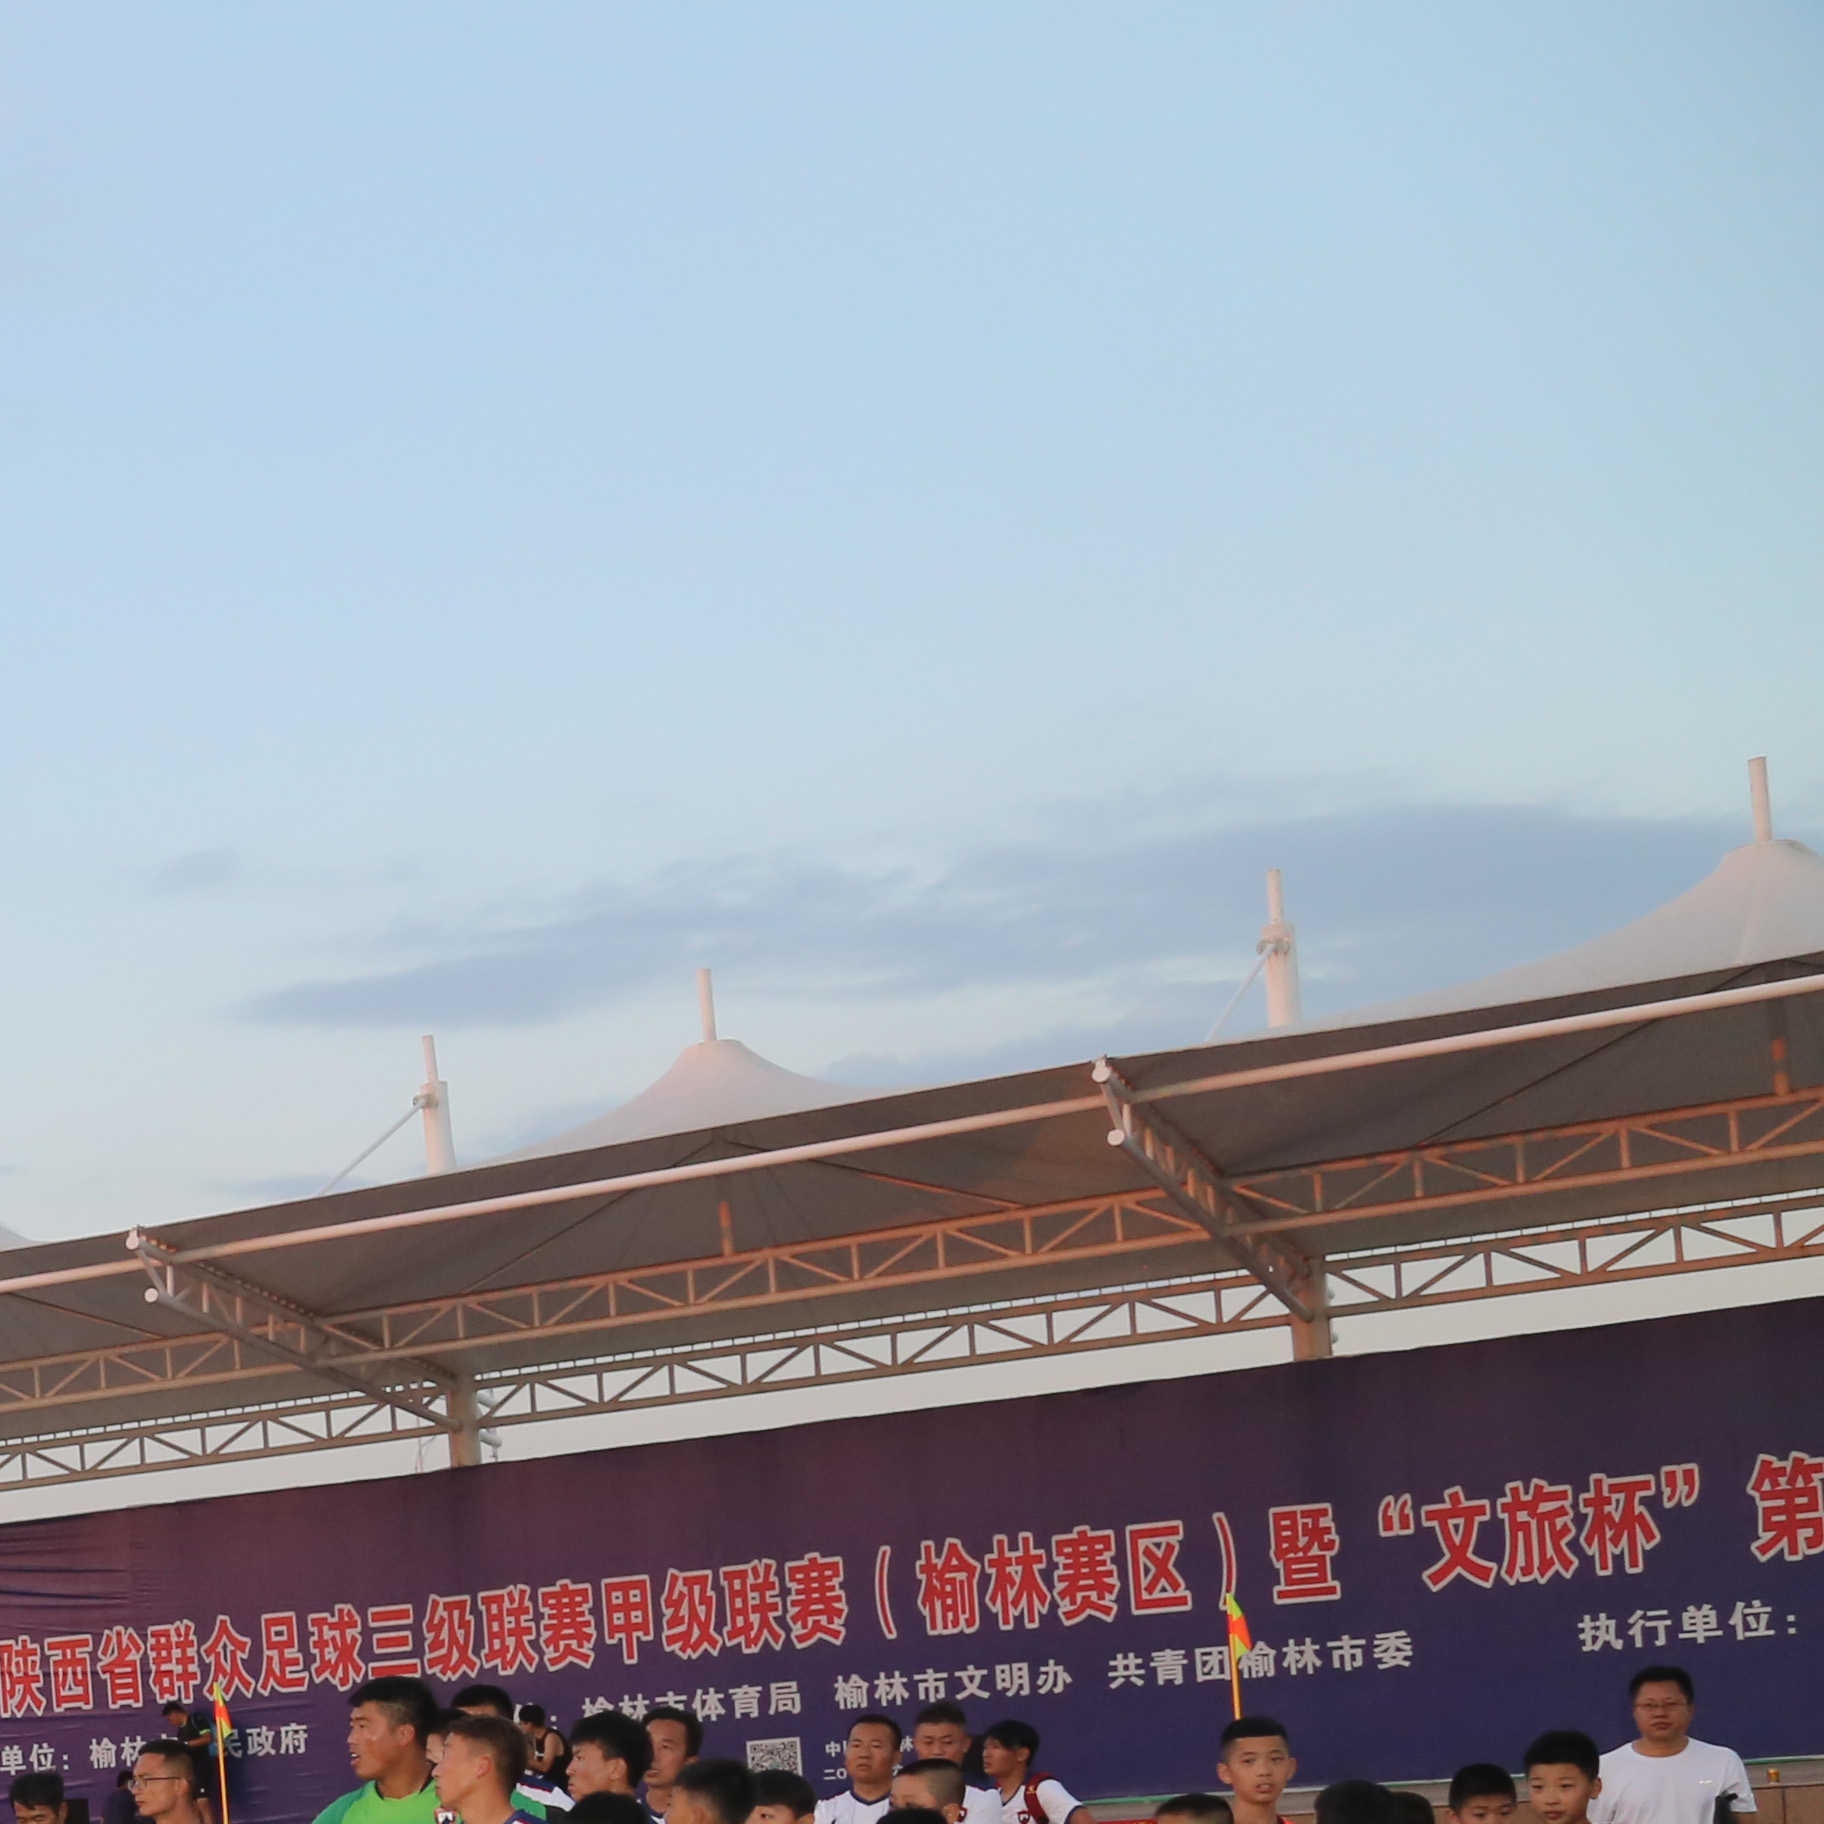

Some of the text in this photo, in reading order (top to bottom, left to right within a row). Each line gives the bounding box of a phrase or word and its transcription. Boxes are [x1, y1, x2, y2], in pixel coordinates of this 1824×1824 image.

[88, 1722, 309, 1770] 榆林民政府
[833, 1660, 1073, 1711] 榆林市文明办
[1107, 1629, 1414, 1689] 共青团榆林市委
[1577, 1599, 1798, 1651] 执行单位：
